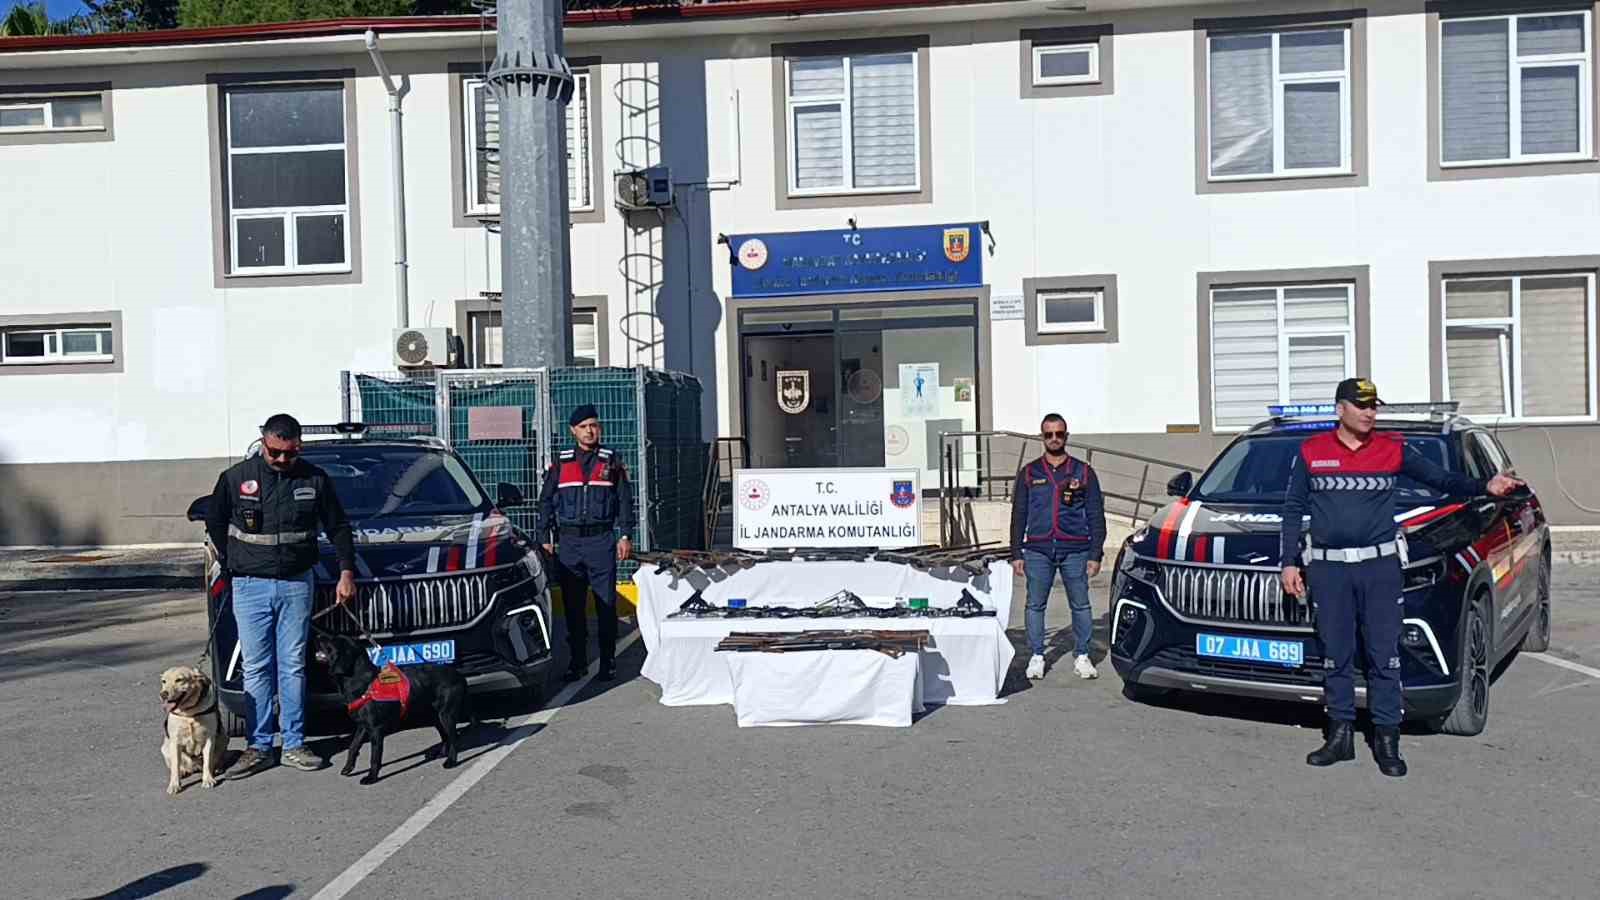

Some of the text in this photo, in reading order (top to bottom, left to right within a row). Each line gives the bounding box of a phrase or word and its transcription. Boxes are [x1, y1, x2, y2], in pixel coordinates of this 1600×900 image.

[815, 482, 838, 495] T.C.
[771, 500, 883, 517] ANTALYA VALİLİĞİ
[740, 522, 915, 539] İL JANDARMA KOMUTANLIĞI
[389, 646, 416, 664] JAA
[423, 642, 450, 661] 690
[1206, 636, 1299, 661] 07 JAA 689
